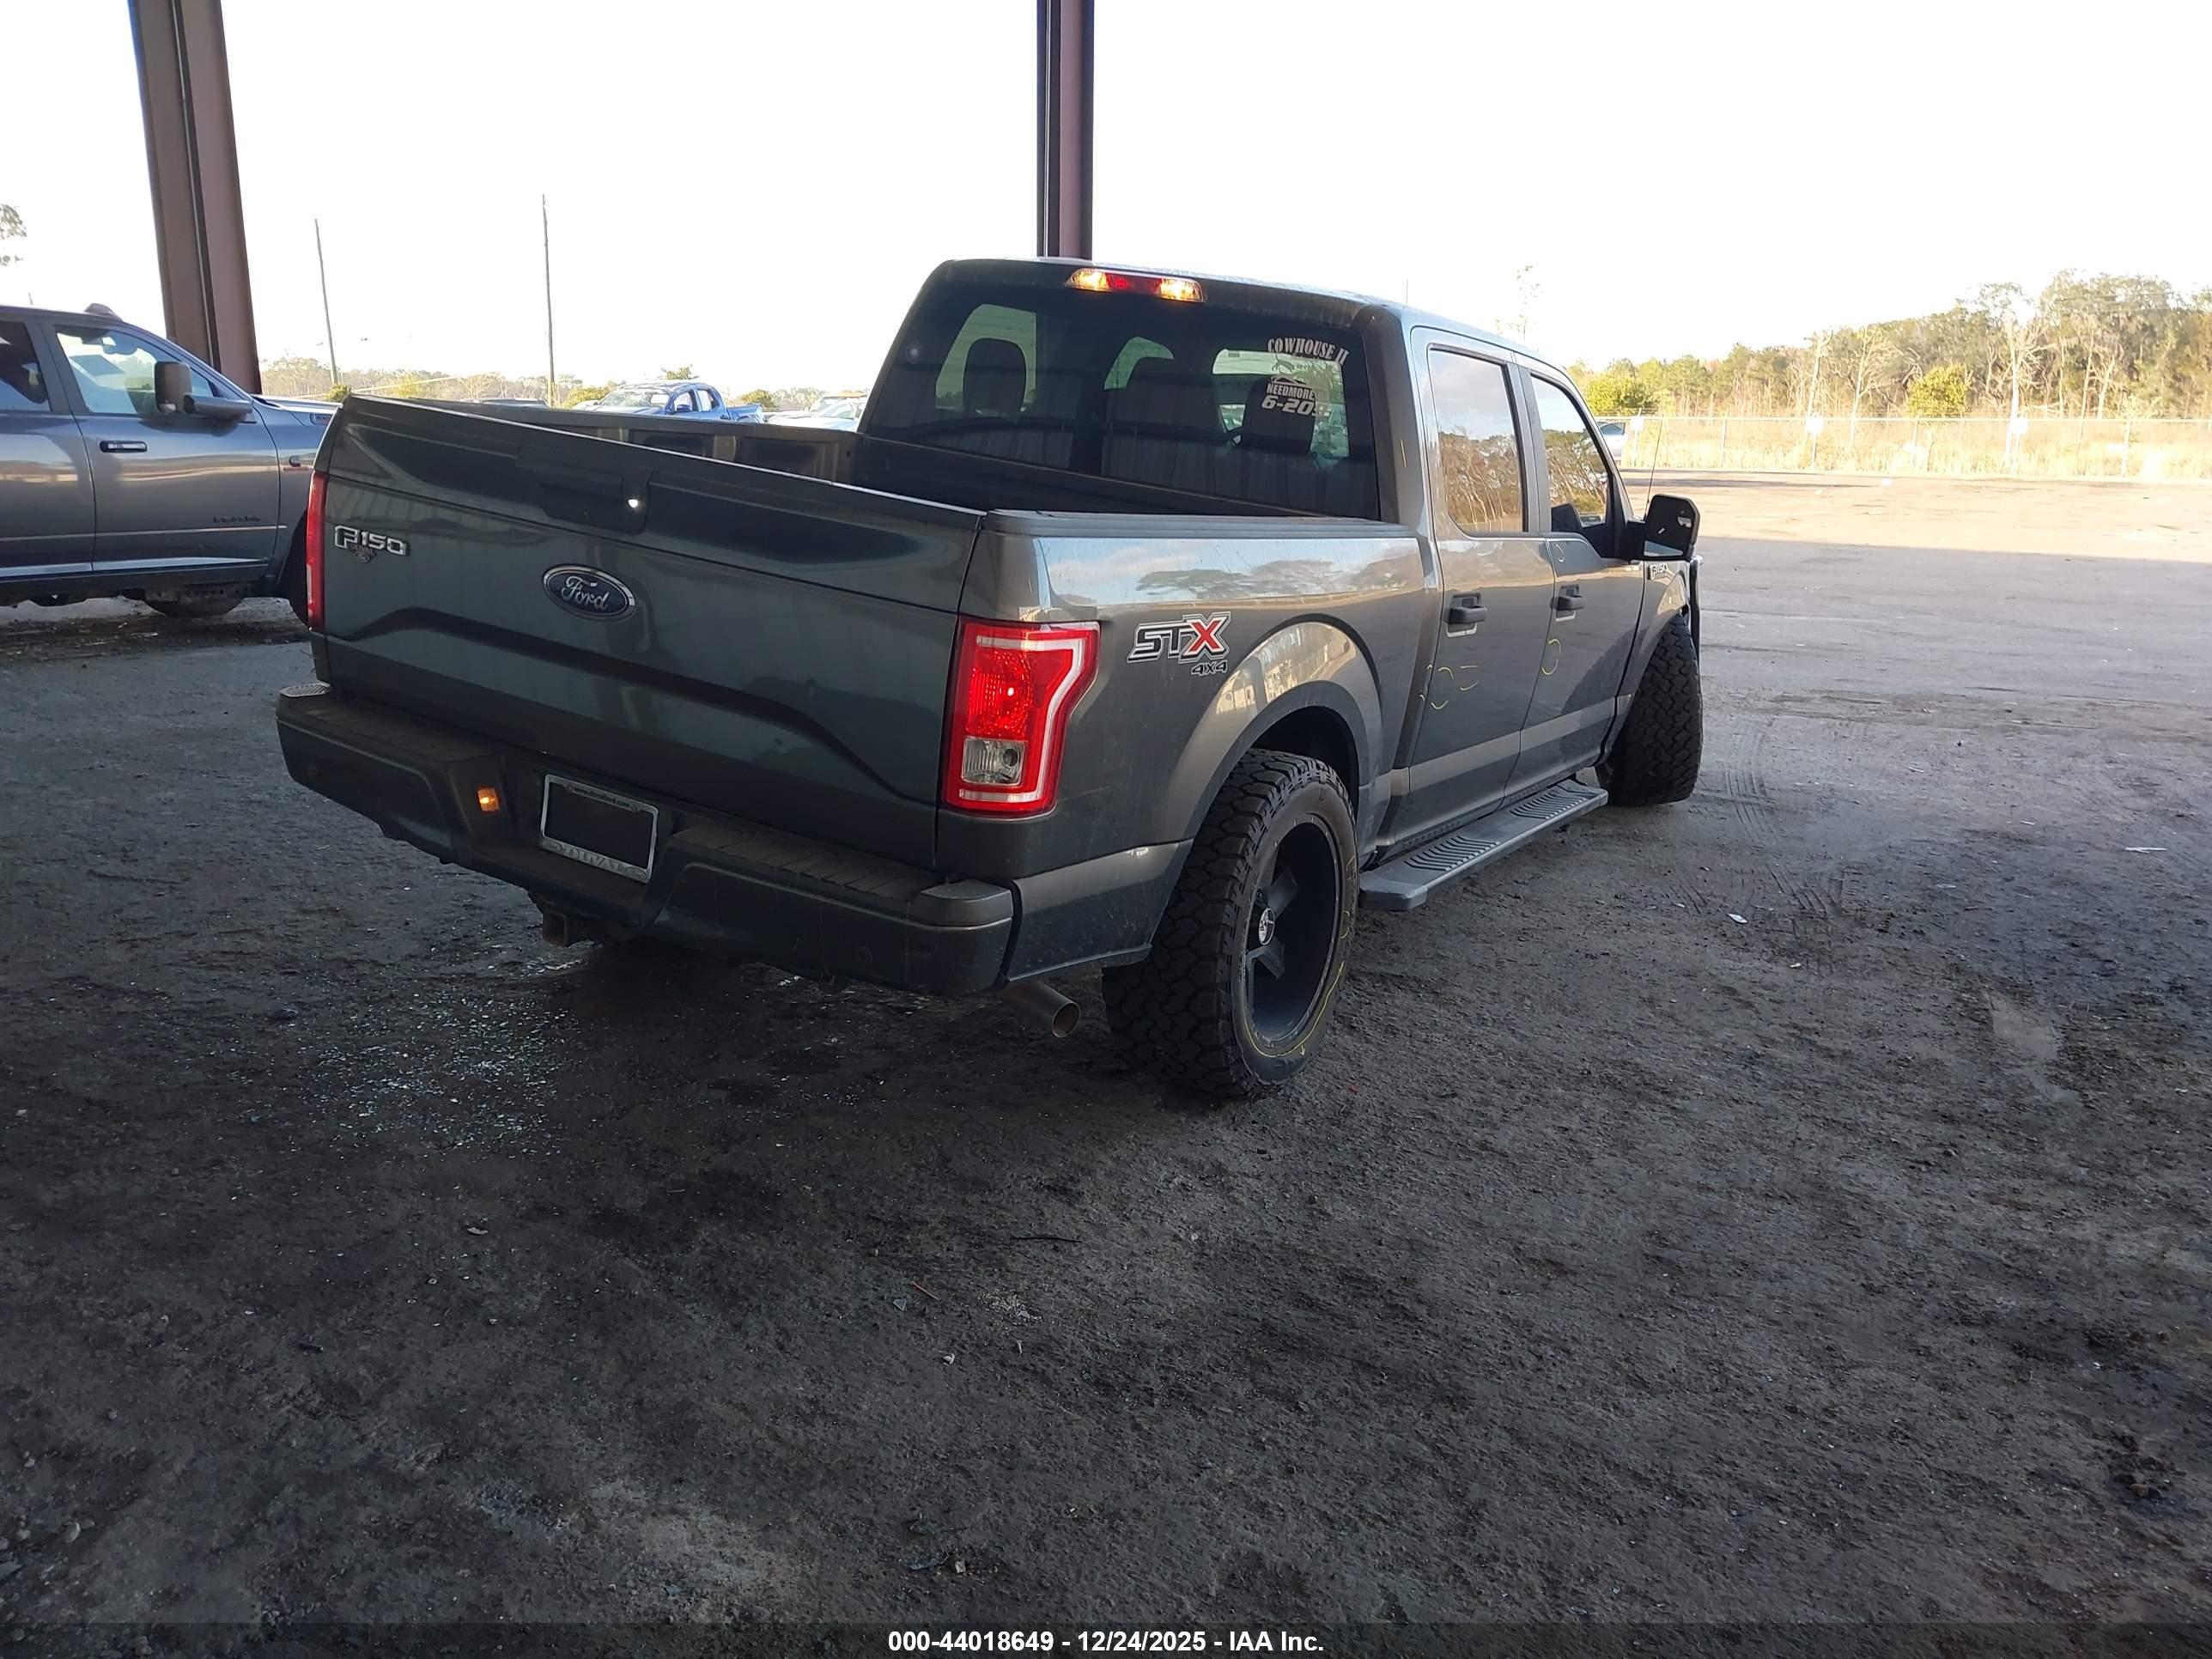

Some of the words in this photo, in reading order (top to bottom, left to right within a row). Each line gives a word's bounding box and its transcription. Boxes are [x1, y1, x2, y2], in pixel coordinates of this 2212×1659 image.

[1267, 337, 1335, 360] COWHOUSE
[1267, 383, 1316, 401] NEEDMORE
[560, 575, 611, 611] Ford
[1127, 611, 1231, 664] STX
